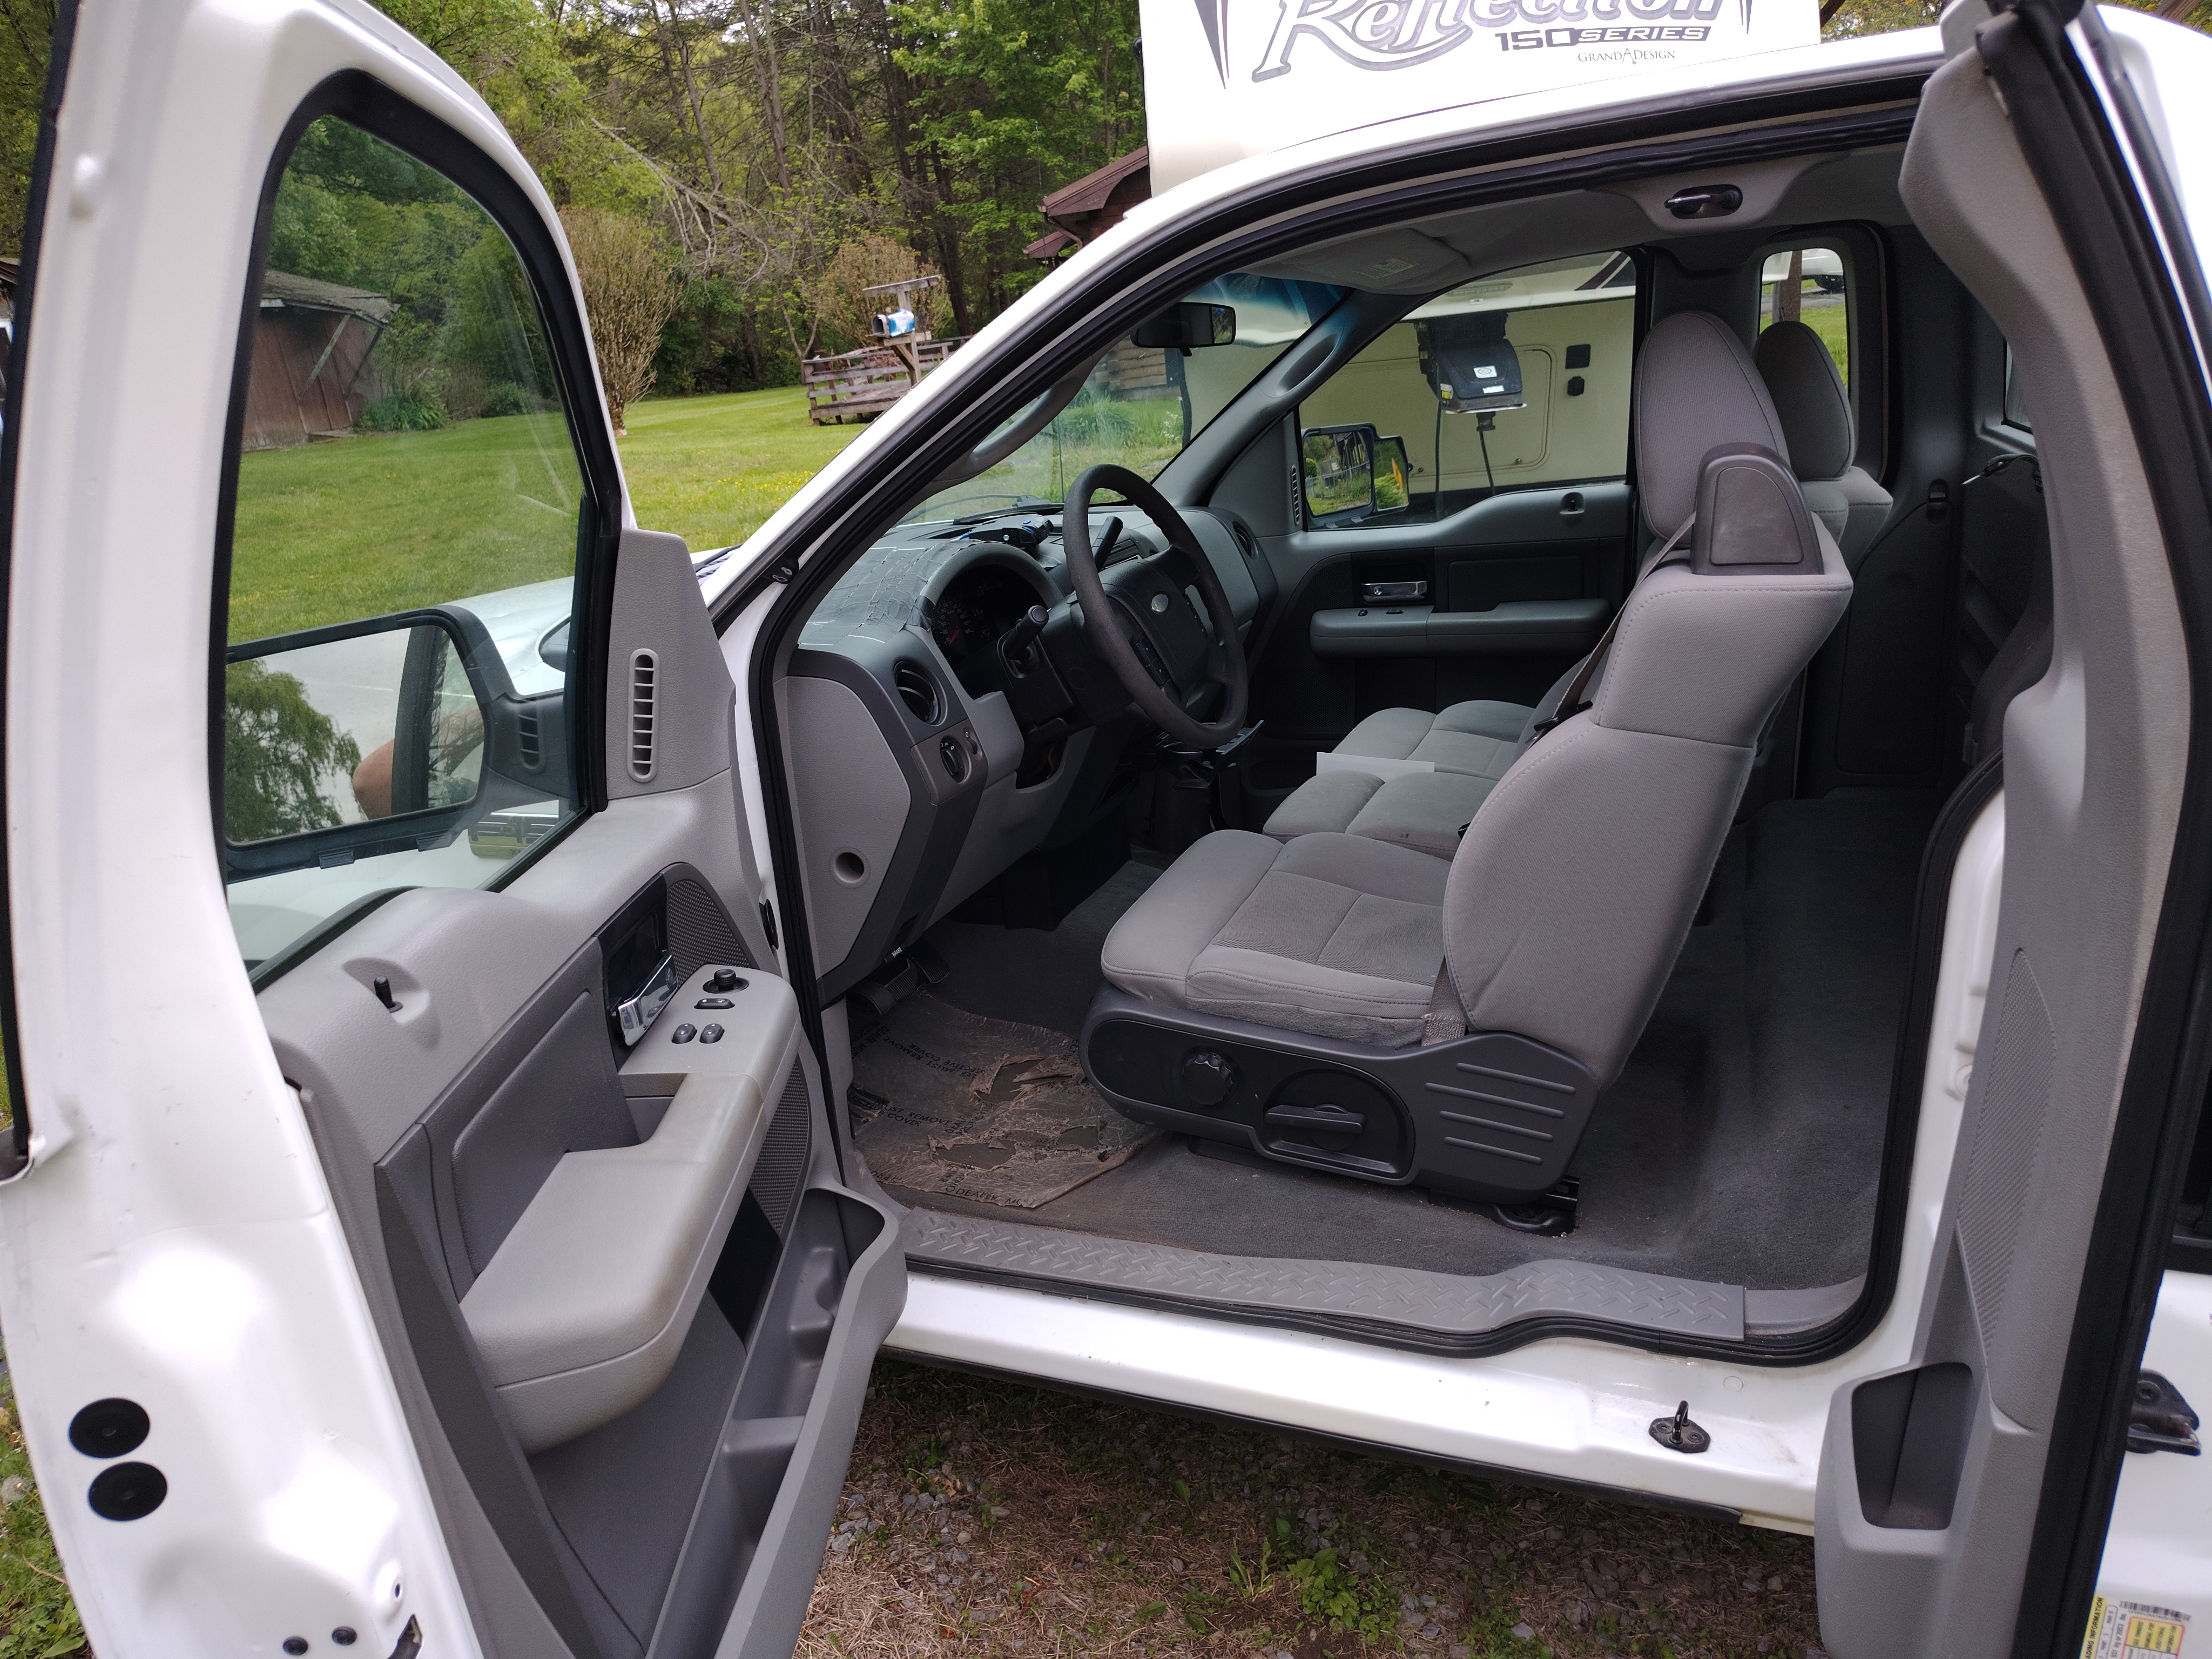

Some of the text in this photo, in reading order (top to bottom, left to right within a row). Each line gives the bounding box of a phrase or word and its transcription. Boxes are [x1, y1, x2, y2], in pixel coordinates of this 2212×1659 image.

[1495, 26, 1705, 51] 150 SERIES
[891, 946, 902, 957] BRAKE
[882, 1036, 923, 1061] REMOVE
[909, 1043, 941, 1062] COVER
[925, 1060, 956, 1074] MUST
[887, 1113, 922, 1127] COVER
[908, 1112, 953, 1125] REMOVE
[955, 1188, 999, 1201] DEALER
[2089, 1596, 2104, 1640] INFORMATION
